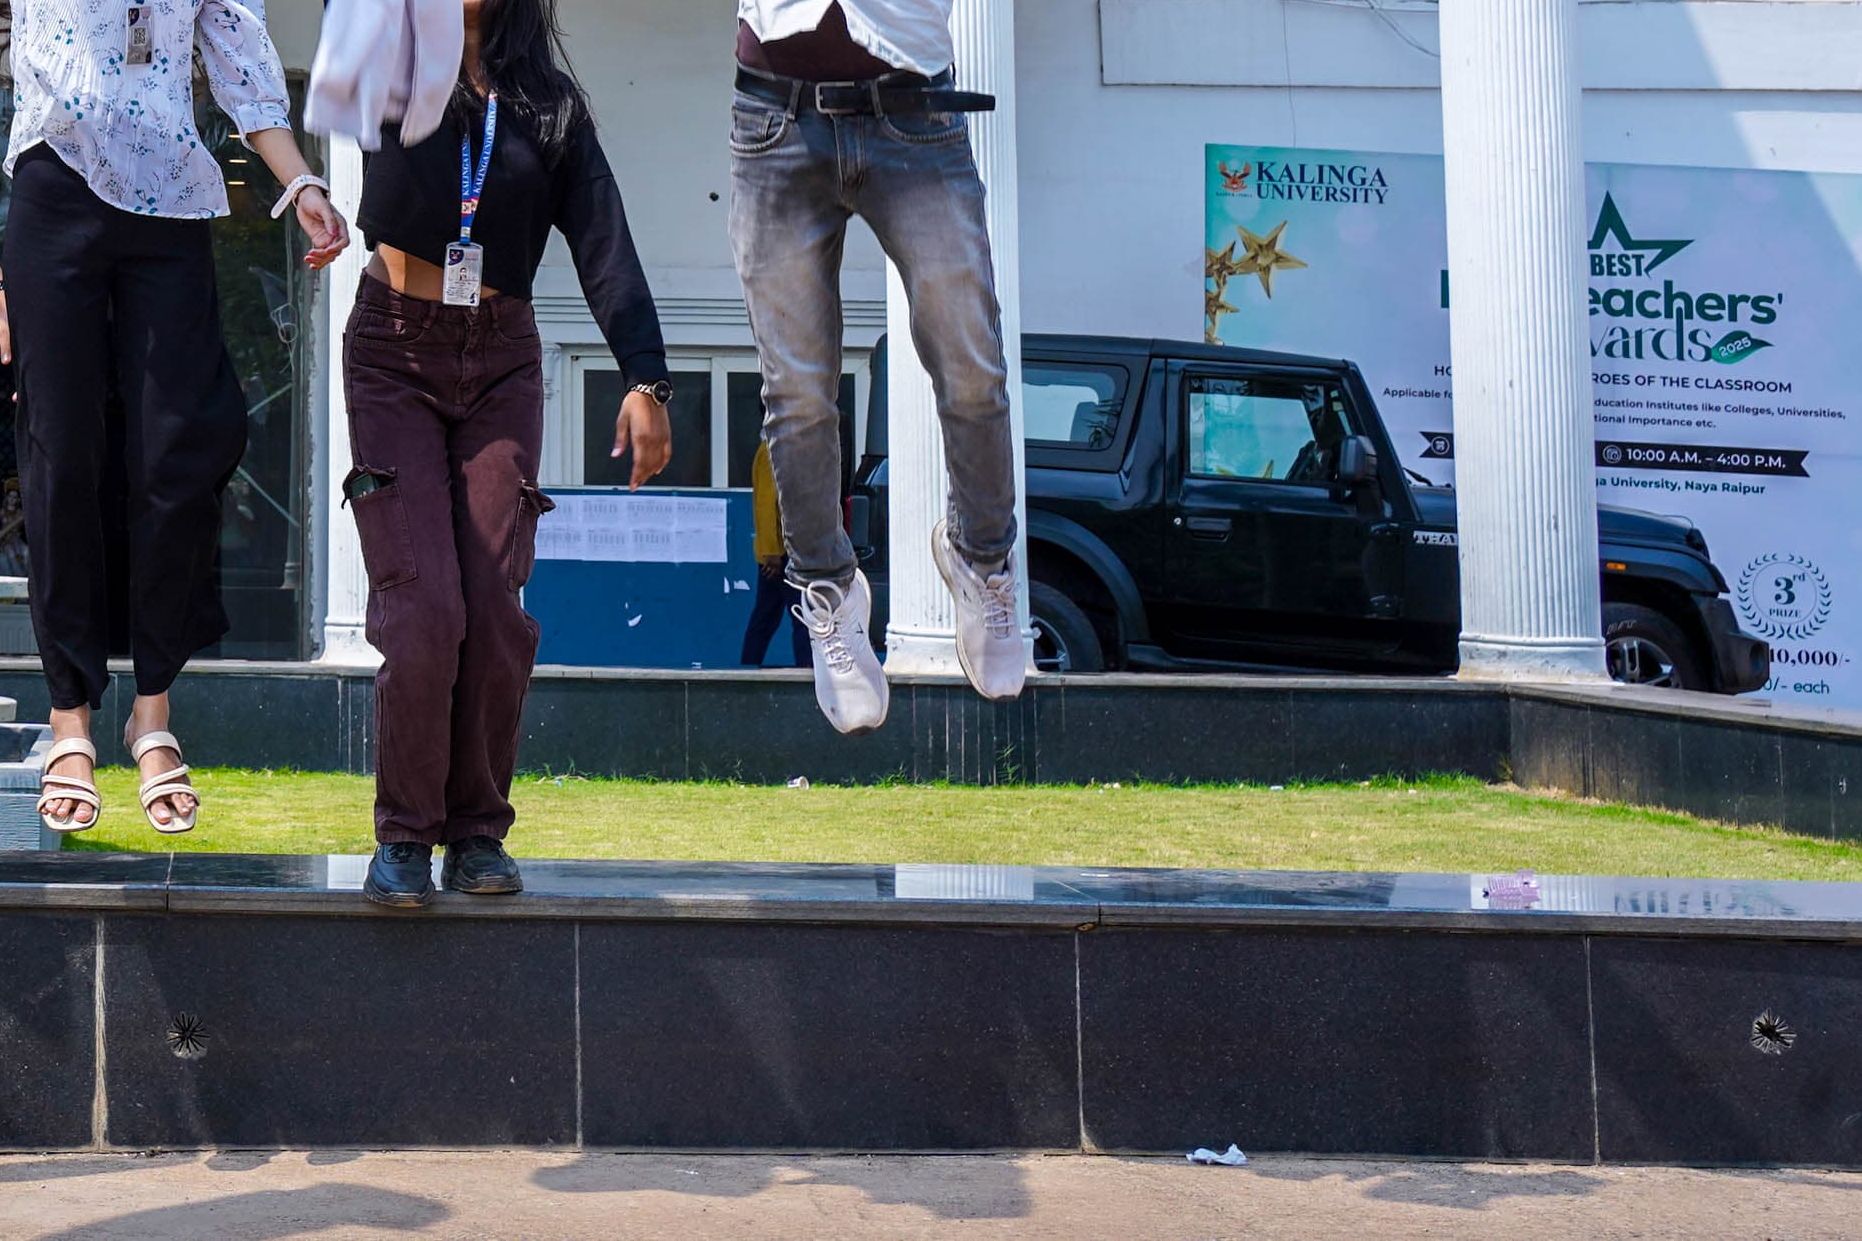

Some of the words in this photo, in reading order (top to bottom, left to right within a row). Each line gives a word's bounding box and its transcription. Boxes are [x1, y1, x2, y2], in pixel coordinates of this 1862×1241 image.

[1256, 161, 1389, 188] KALINGA
[1256, 184, 1389, 205] UNIVERSITY
[1590, 253, 1645, 277] BEST
[1589, 279, 1783, 325] achers'
[1590, 306, 1712, 362] ards
[1718, 336, 1752, 358] 2025
[1592, 372, 1631, 386] ROES
[1634, 374, 1656, 387] OF
[1660, 376, 1691, 389] THE
[1694, 377, 1792, 394] CLASSROOM
[1383, 388, 1441, 400] Applicable
[1443, 390, 1453, 399] fo
[1594, 398, 1644, 409] ducation
[1646, 400, 1699, 412] Institutes
[1701, 402, 1722, 413] like
[1724, 404, 1775, 417] Colleges,
[1777, 406, 1847, 421] Universities,
[1594, 414, 1626, 423] tional
[1628, 415, 1693, 427] Importance
[1695, 418, 1717, 429] etc.
[1626, 448, 1666, 463] 10:00
[1669, 450, 1703, 465] A.M.
[1717, 453, 1751, 467] 4:00
[1754, 455, 1787, 469] P.M.
[1610, 476, 1682, 492] University,
[1684, 481, 1718, 494] Naya
[1721, 482, 1766, 496] Raipur
[1413, 530, 1458, 546] THA
[1768, 609, 1801, 619] PRIZE
[1793, 679, 1830, 695] each
